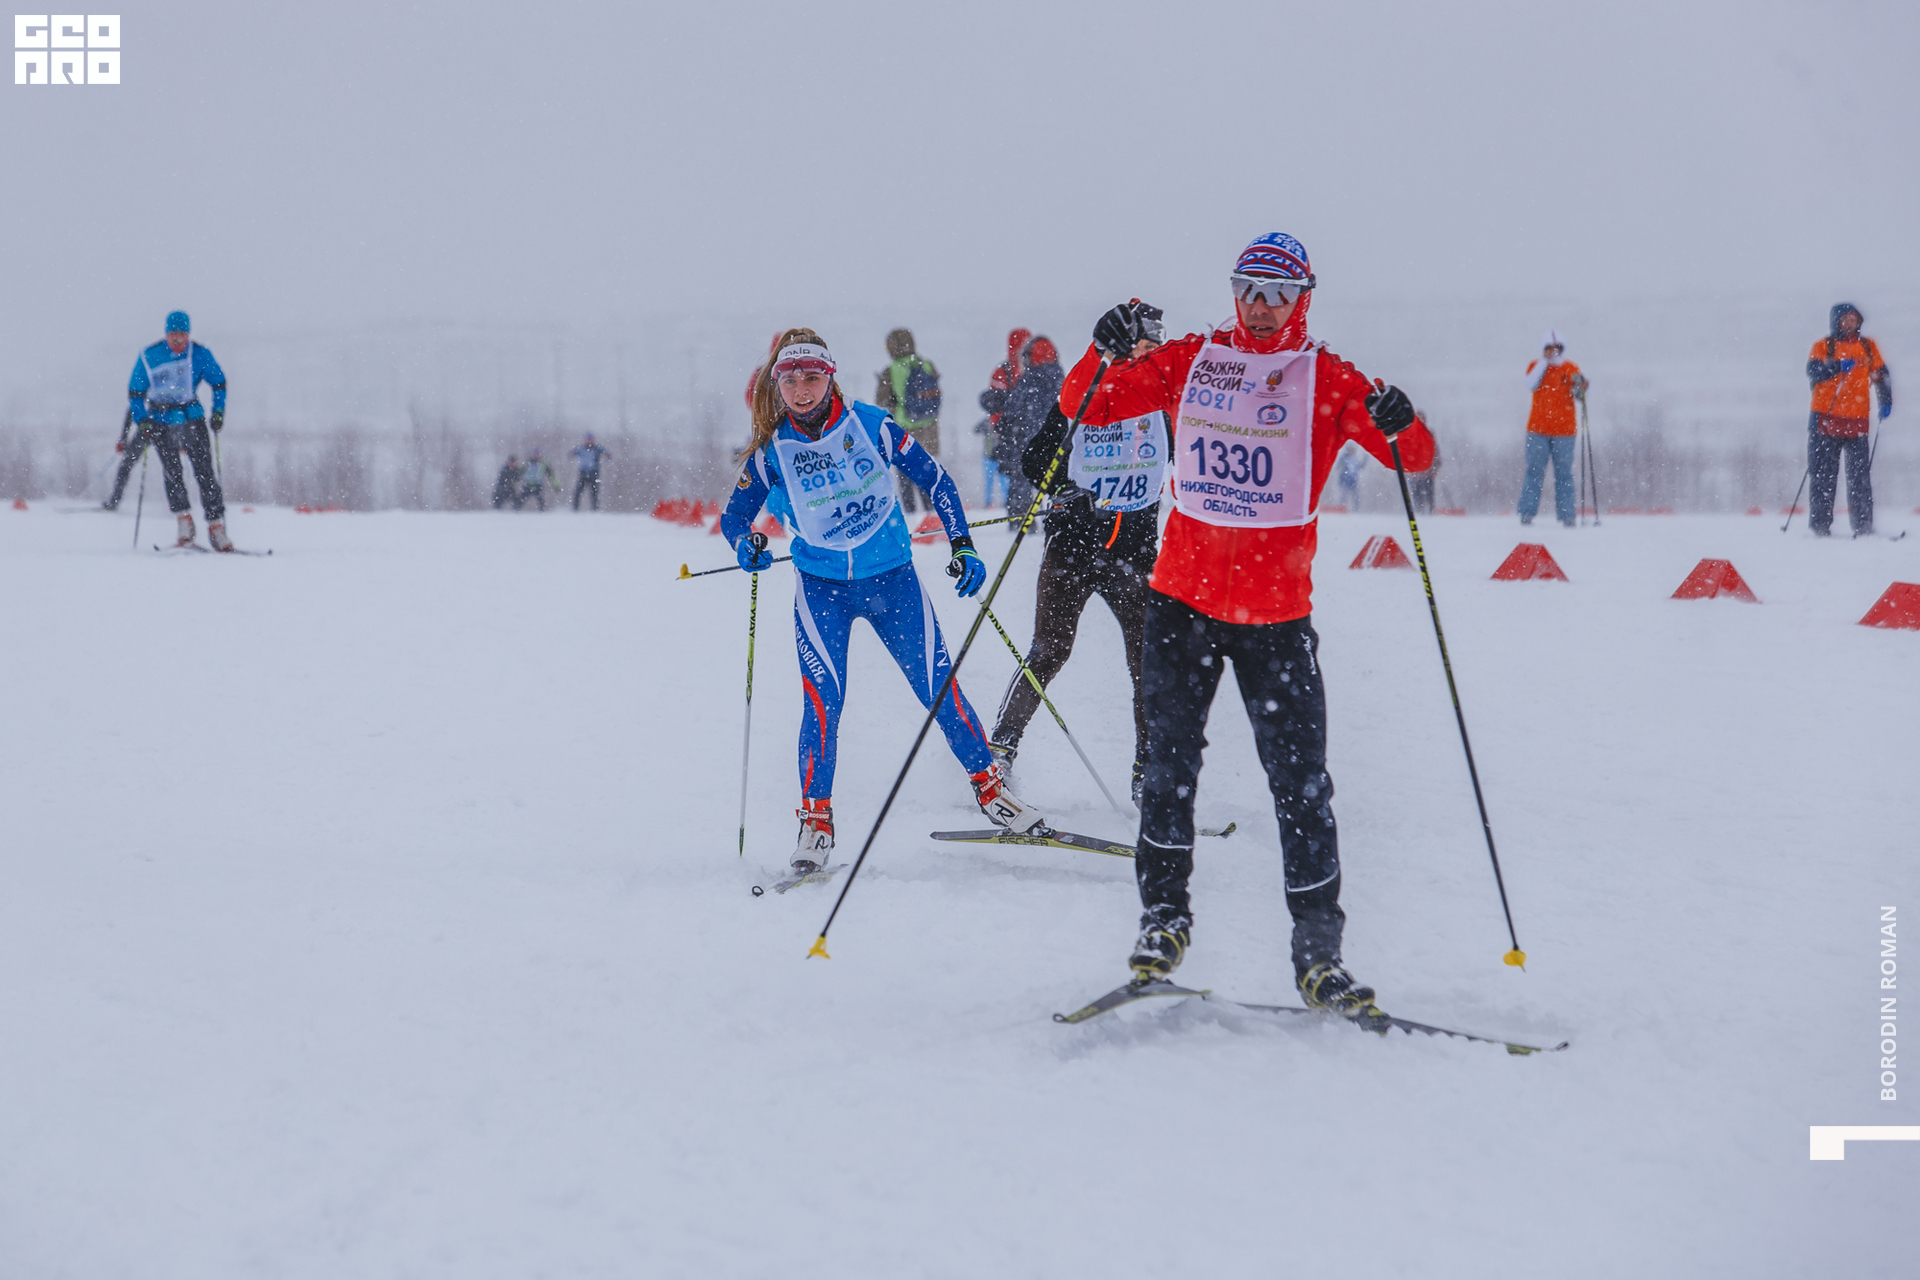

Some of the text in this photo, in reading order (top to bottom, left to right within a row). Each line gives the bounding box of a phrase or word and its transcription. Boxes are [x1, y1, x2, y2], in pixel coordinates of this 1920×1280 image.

[1194, 359, 1247, 376] ЛЫЖНЯ
[1190, 371, 1243, 392] РОССИИ
[1185, 386, 1234, 412] 2021
[1084, 432, 1124, 444] РОССИИ
[1181, 415, 1289, 438] СПОРТ НОРМА ЖИЗНИ
[1083, 444, 1123, 458] 2021
[1190, 436, 1273, 487] 1330
[1040, 447, 1064, 490] LEKI
[800, 470, 845, 493] 2021
[1090, 473, 1149, 502] 1748
[1180, 480, 1284, 504] НИЖЕГОРОДСКАЯ
[1203, 499, 1258, 518] ОБЛАСТЬ
[845, 512, 879, 540] ОБЛАСТЬ
[1410, 520, 1425, 556] LEKI
[749, 607, 757, 639] WAY
[998, 837, 1048, 847] FISCHER
